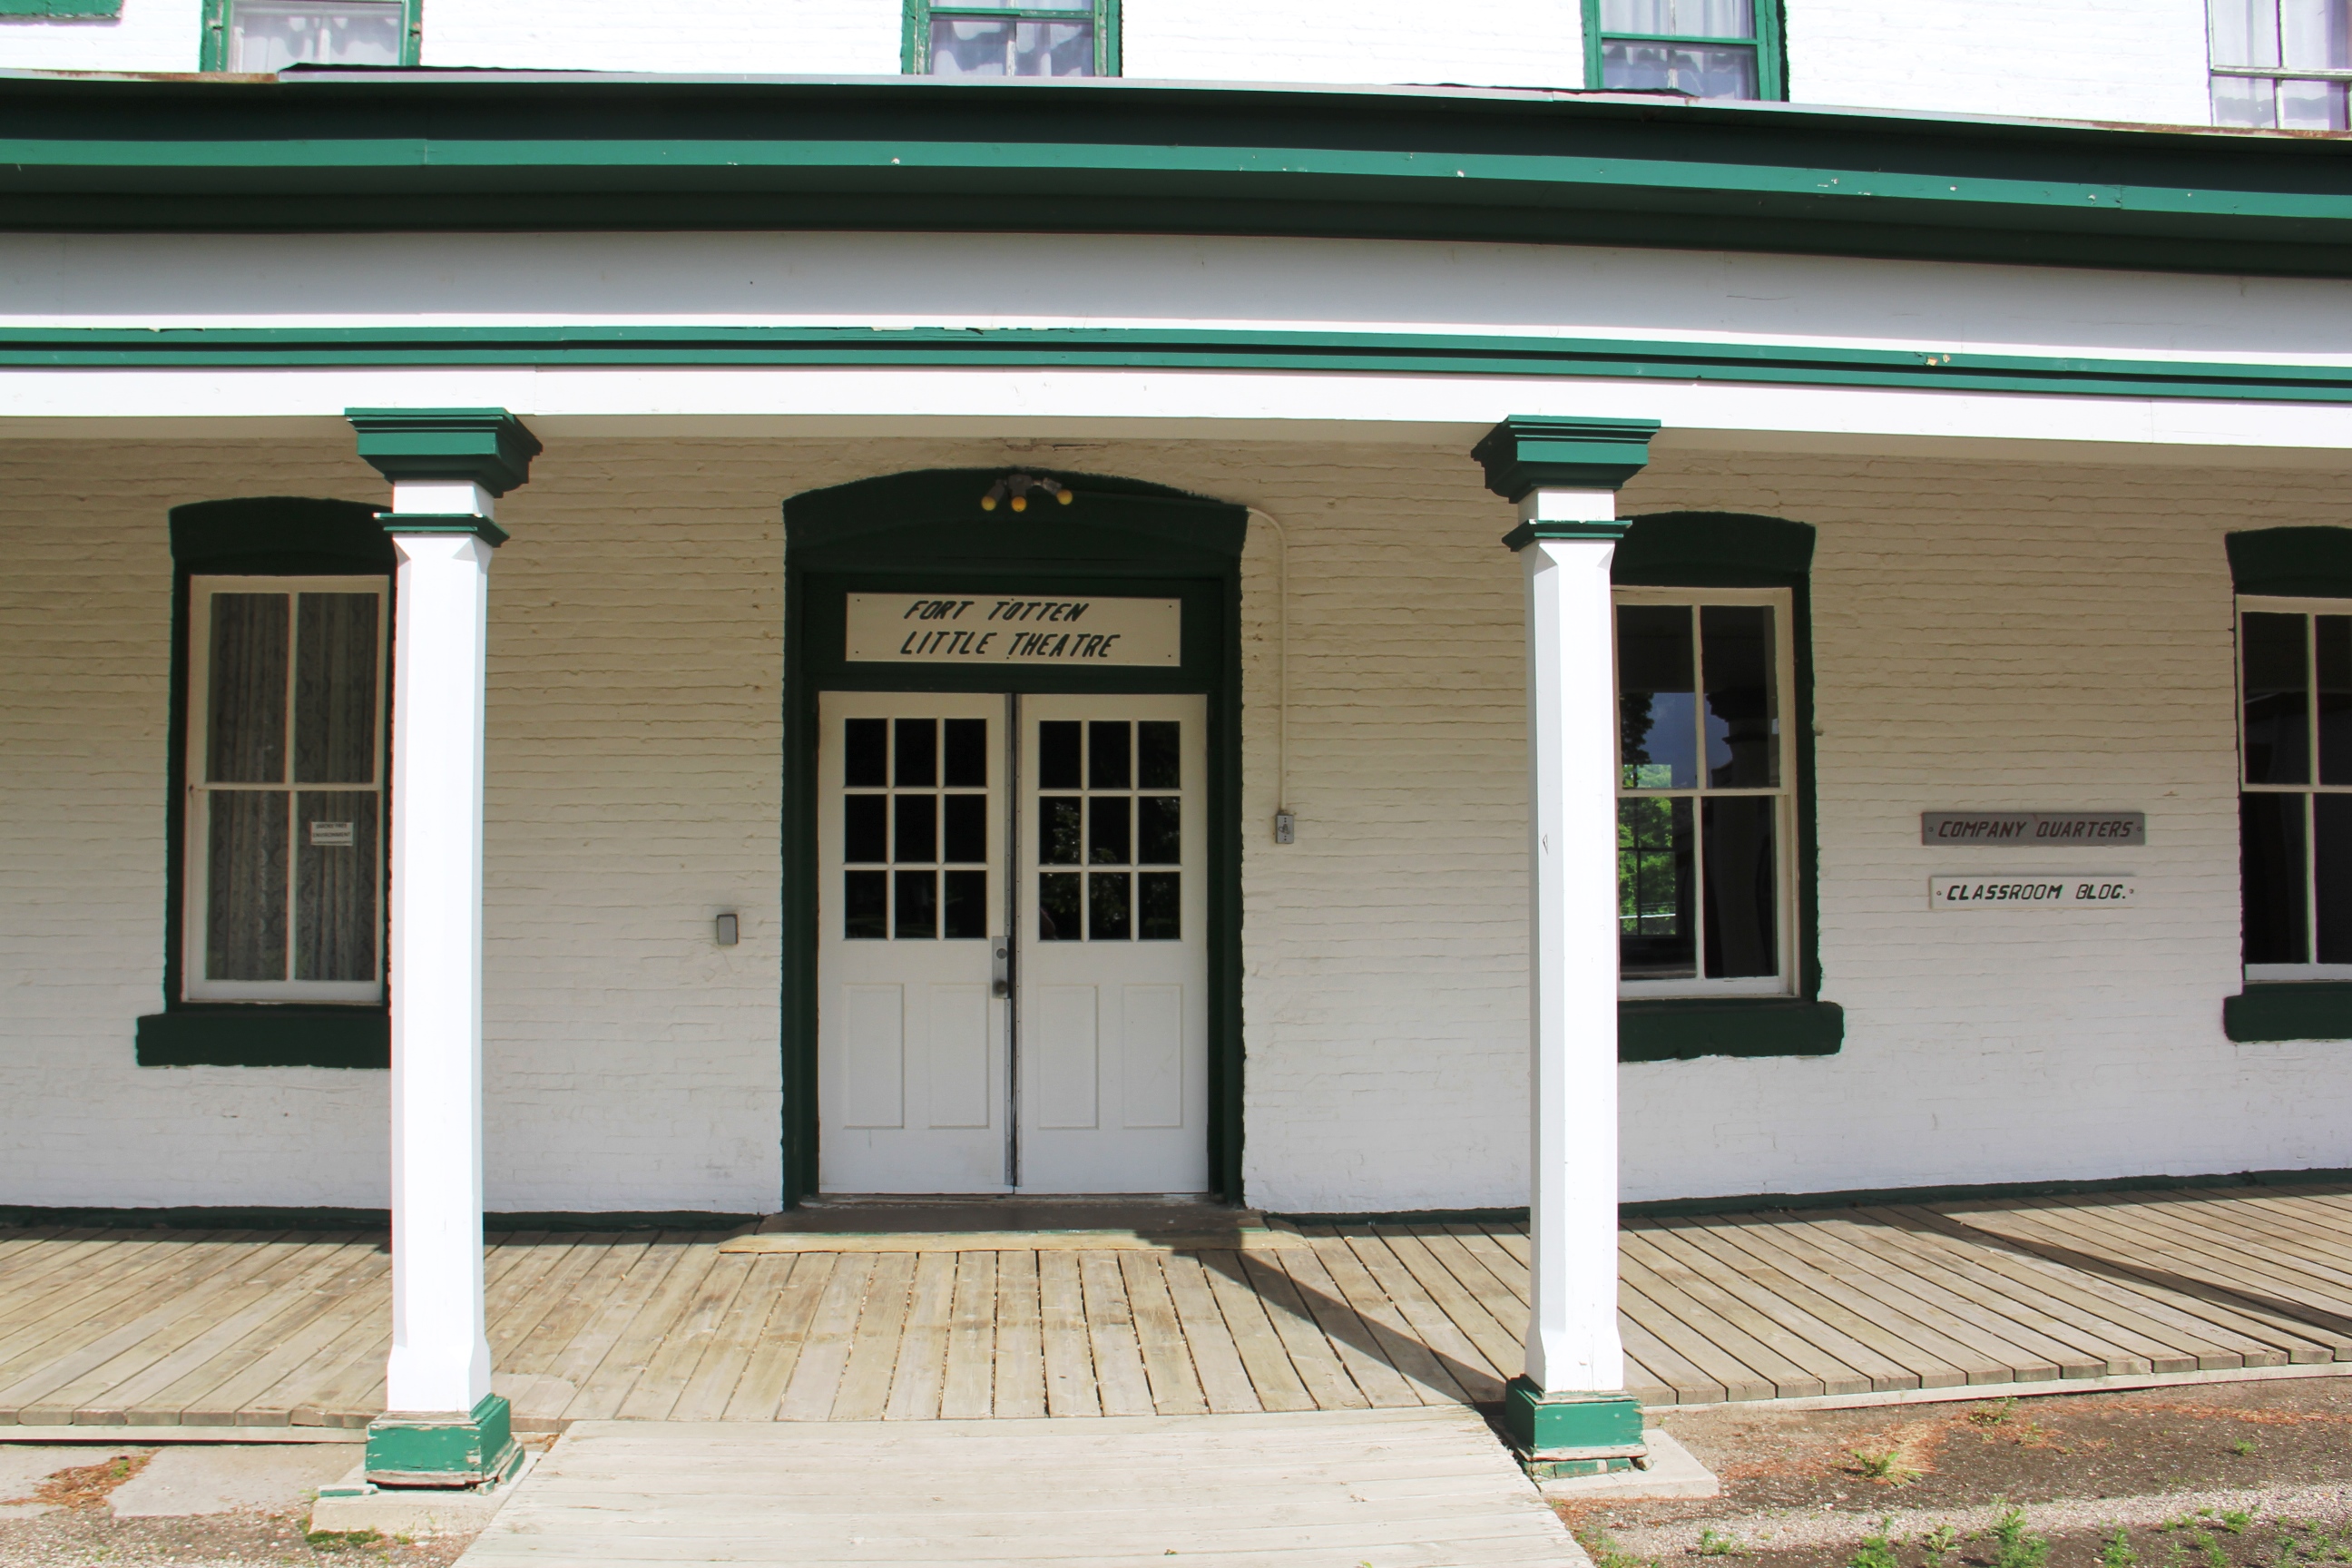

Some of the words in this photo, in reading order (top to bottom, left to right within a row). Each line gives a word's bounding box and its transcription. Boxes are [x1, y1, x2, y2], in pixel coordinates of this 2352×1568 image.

[904, 600, 975, 621] FORT
[987, 602, 1089, 622] TOTTEN
[900, 631, 998, 655] LITTLE
[1007, 632, 1122, 658] THEATRE
[1938, 820, 2027, 838] COMPANY
[2036, 820, 2134, 838] QUARTERS
[1946, 884, 2064, 901] CLASSROOM
